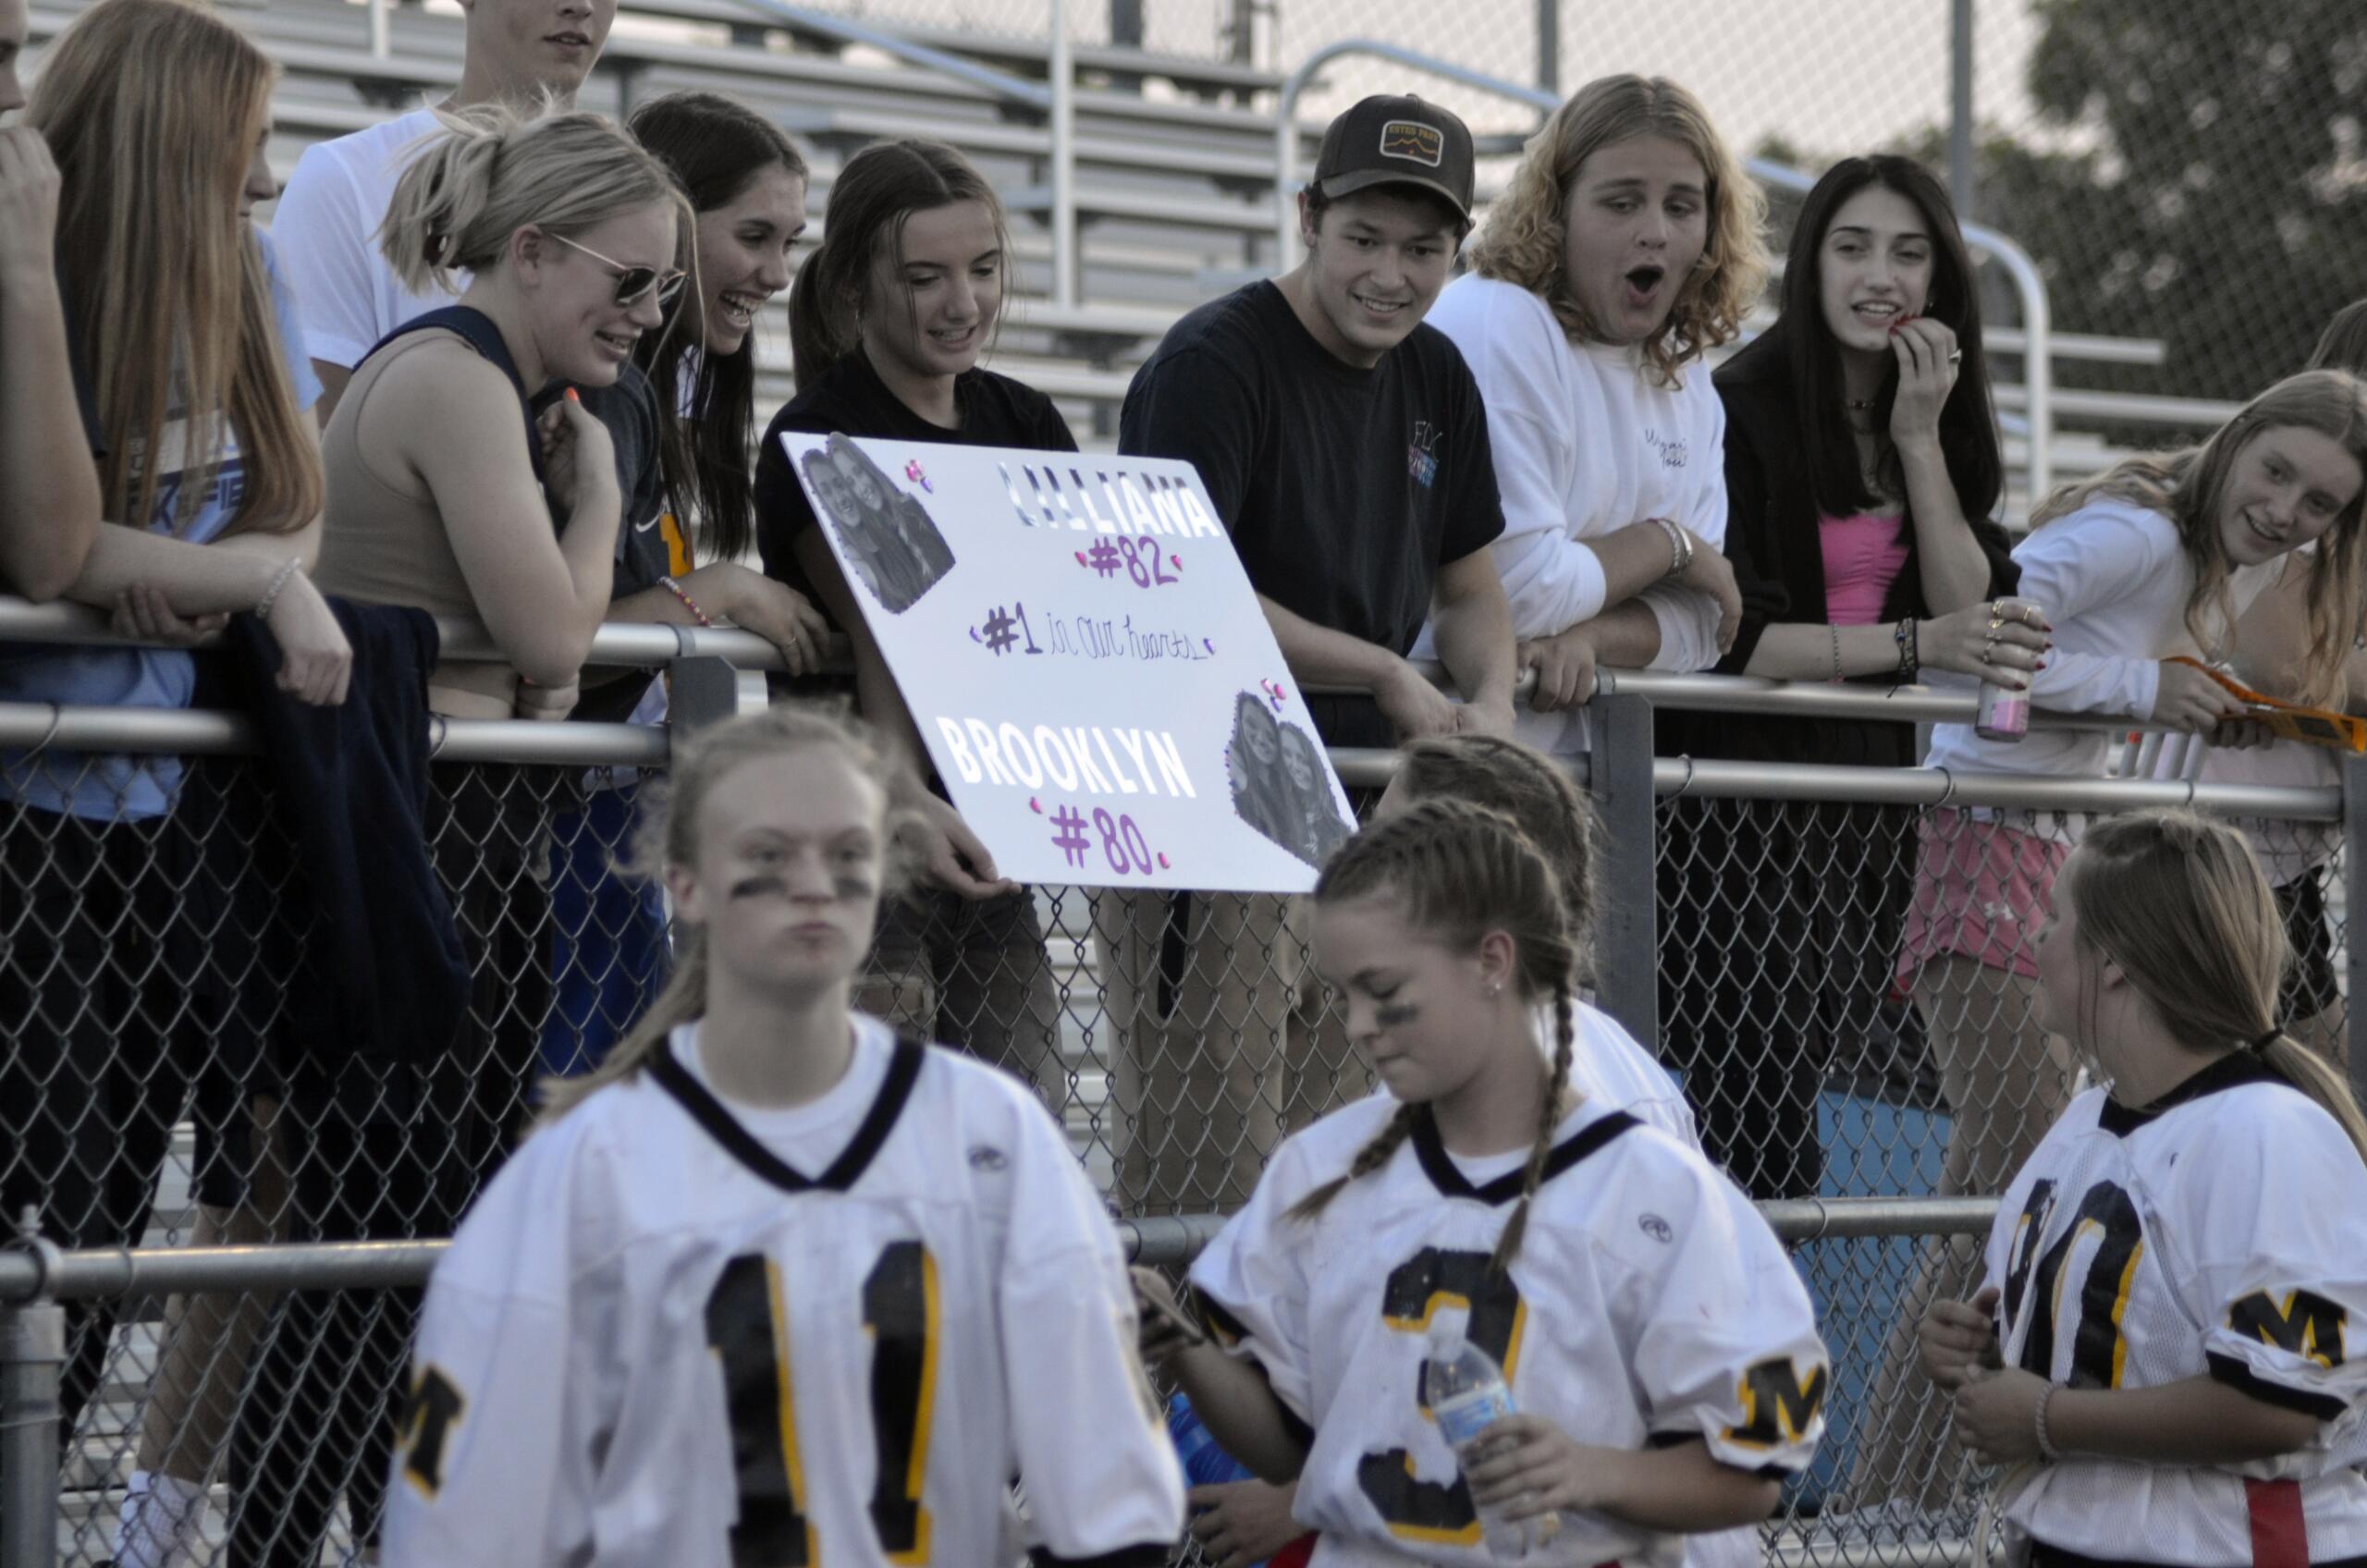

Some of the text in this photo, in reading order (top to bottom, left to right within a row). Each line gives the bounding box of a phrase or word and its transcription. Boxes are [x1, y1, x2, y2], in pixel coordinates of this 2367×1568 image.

[1087, 534, 1179, 589] #82
[982, 601, 1044, 657] #1
[1045, 611, 1078, 655] in
[1075, 615, 1125, 660] our
[936, 716, 1196, 799] BROOKLYN
[1049, 802, 1154, 876] #80
[2226, 1286, 2349, 1370] M
[705, 1240, 942, 1568] 11
[1357, 1245, 1527, 1547] 3
[1719, 1355, 1828, 1452] M
